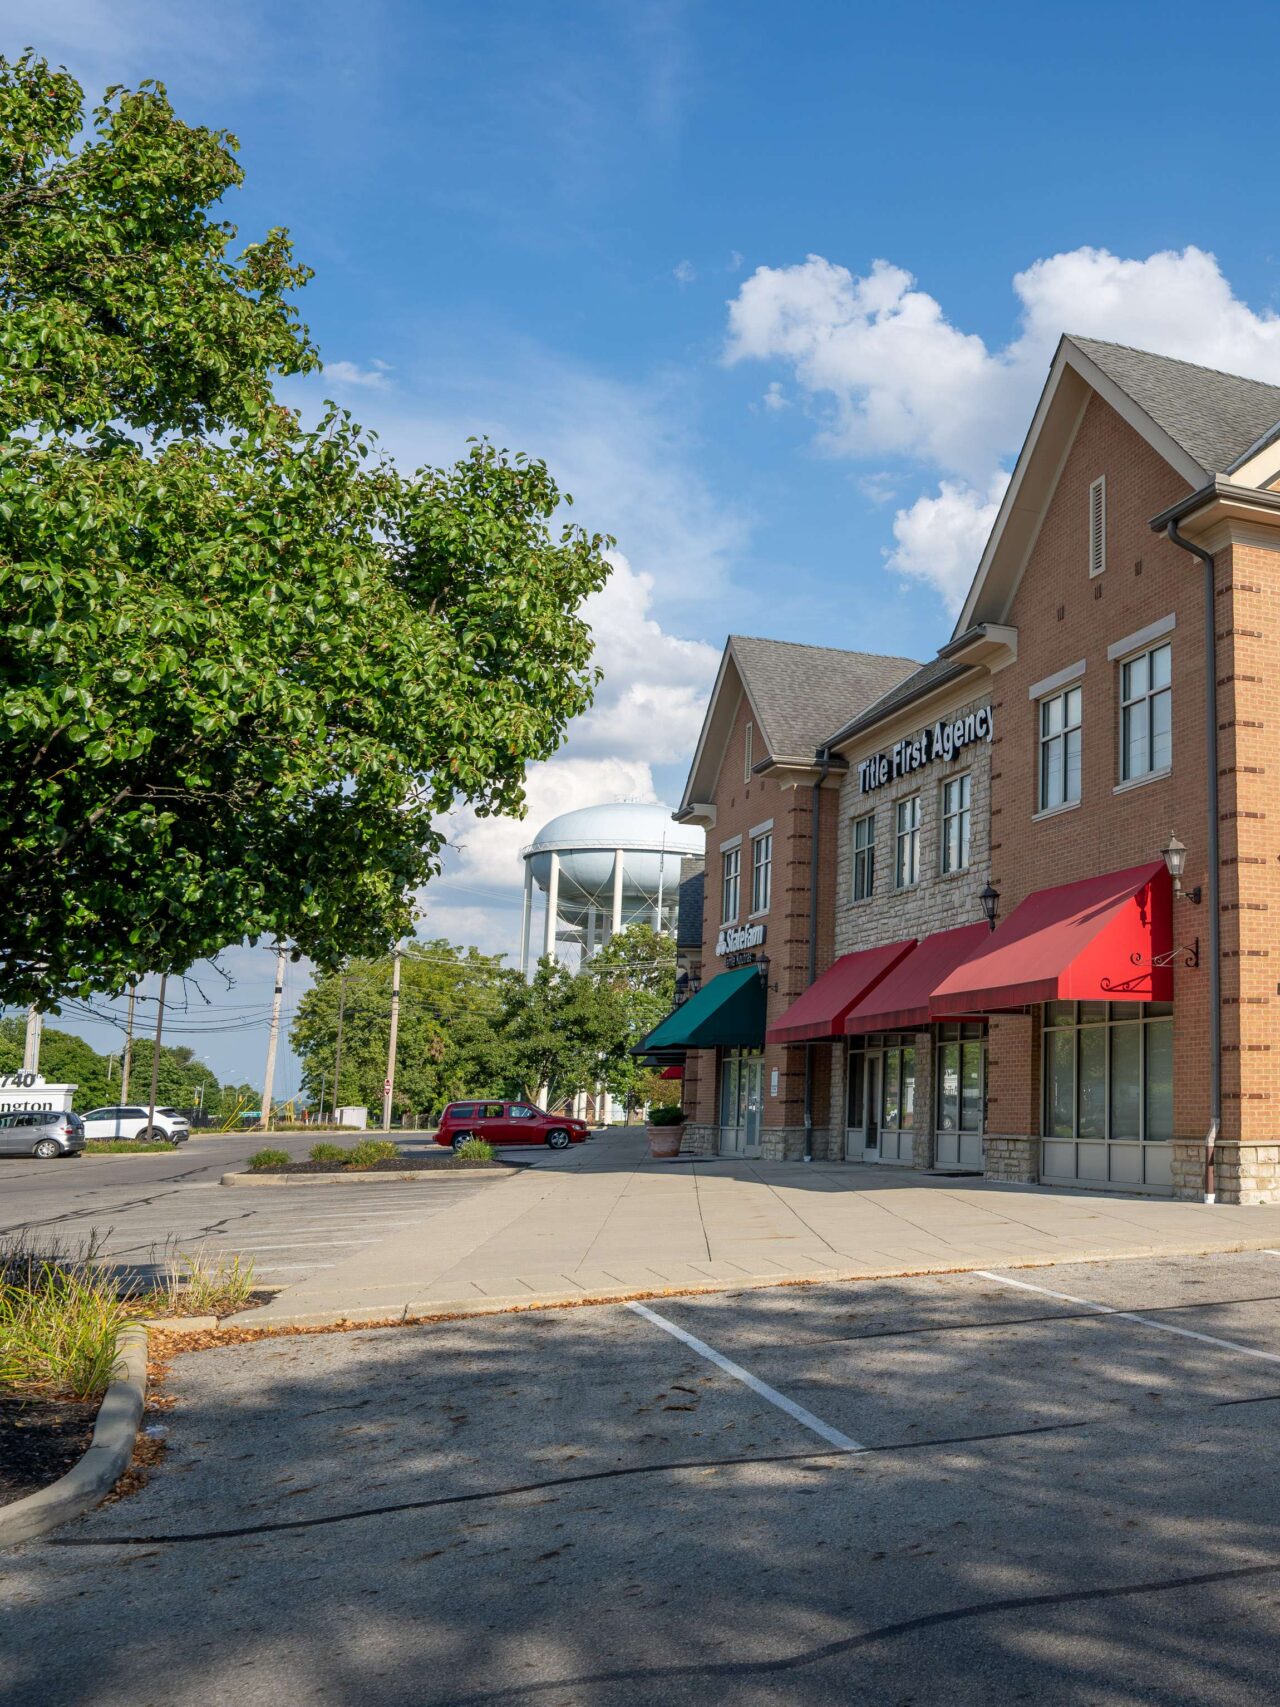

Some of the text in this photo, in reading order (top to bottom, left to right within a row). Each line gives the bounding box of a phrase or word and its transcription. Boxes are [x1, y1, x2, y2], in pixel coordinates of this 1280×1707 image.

[858, 705, 993, 793] Title First Agency
